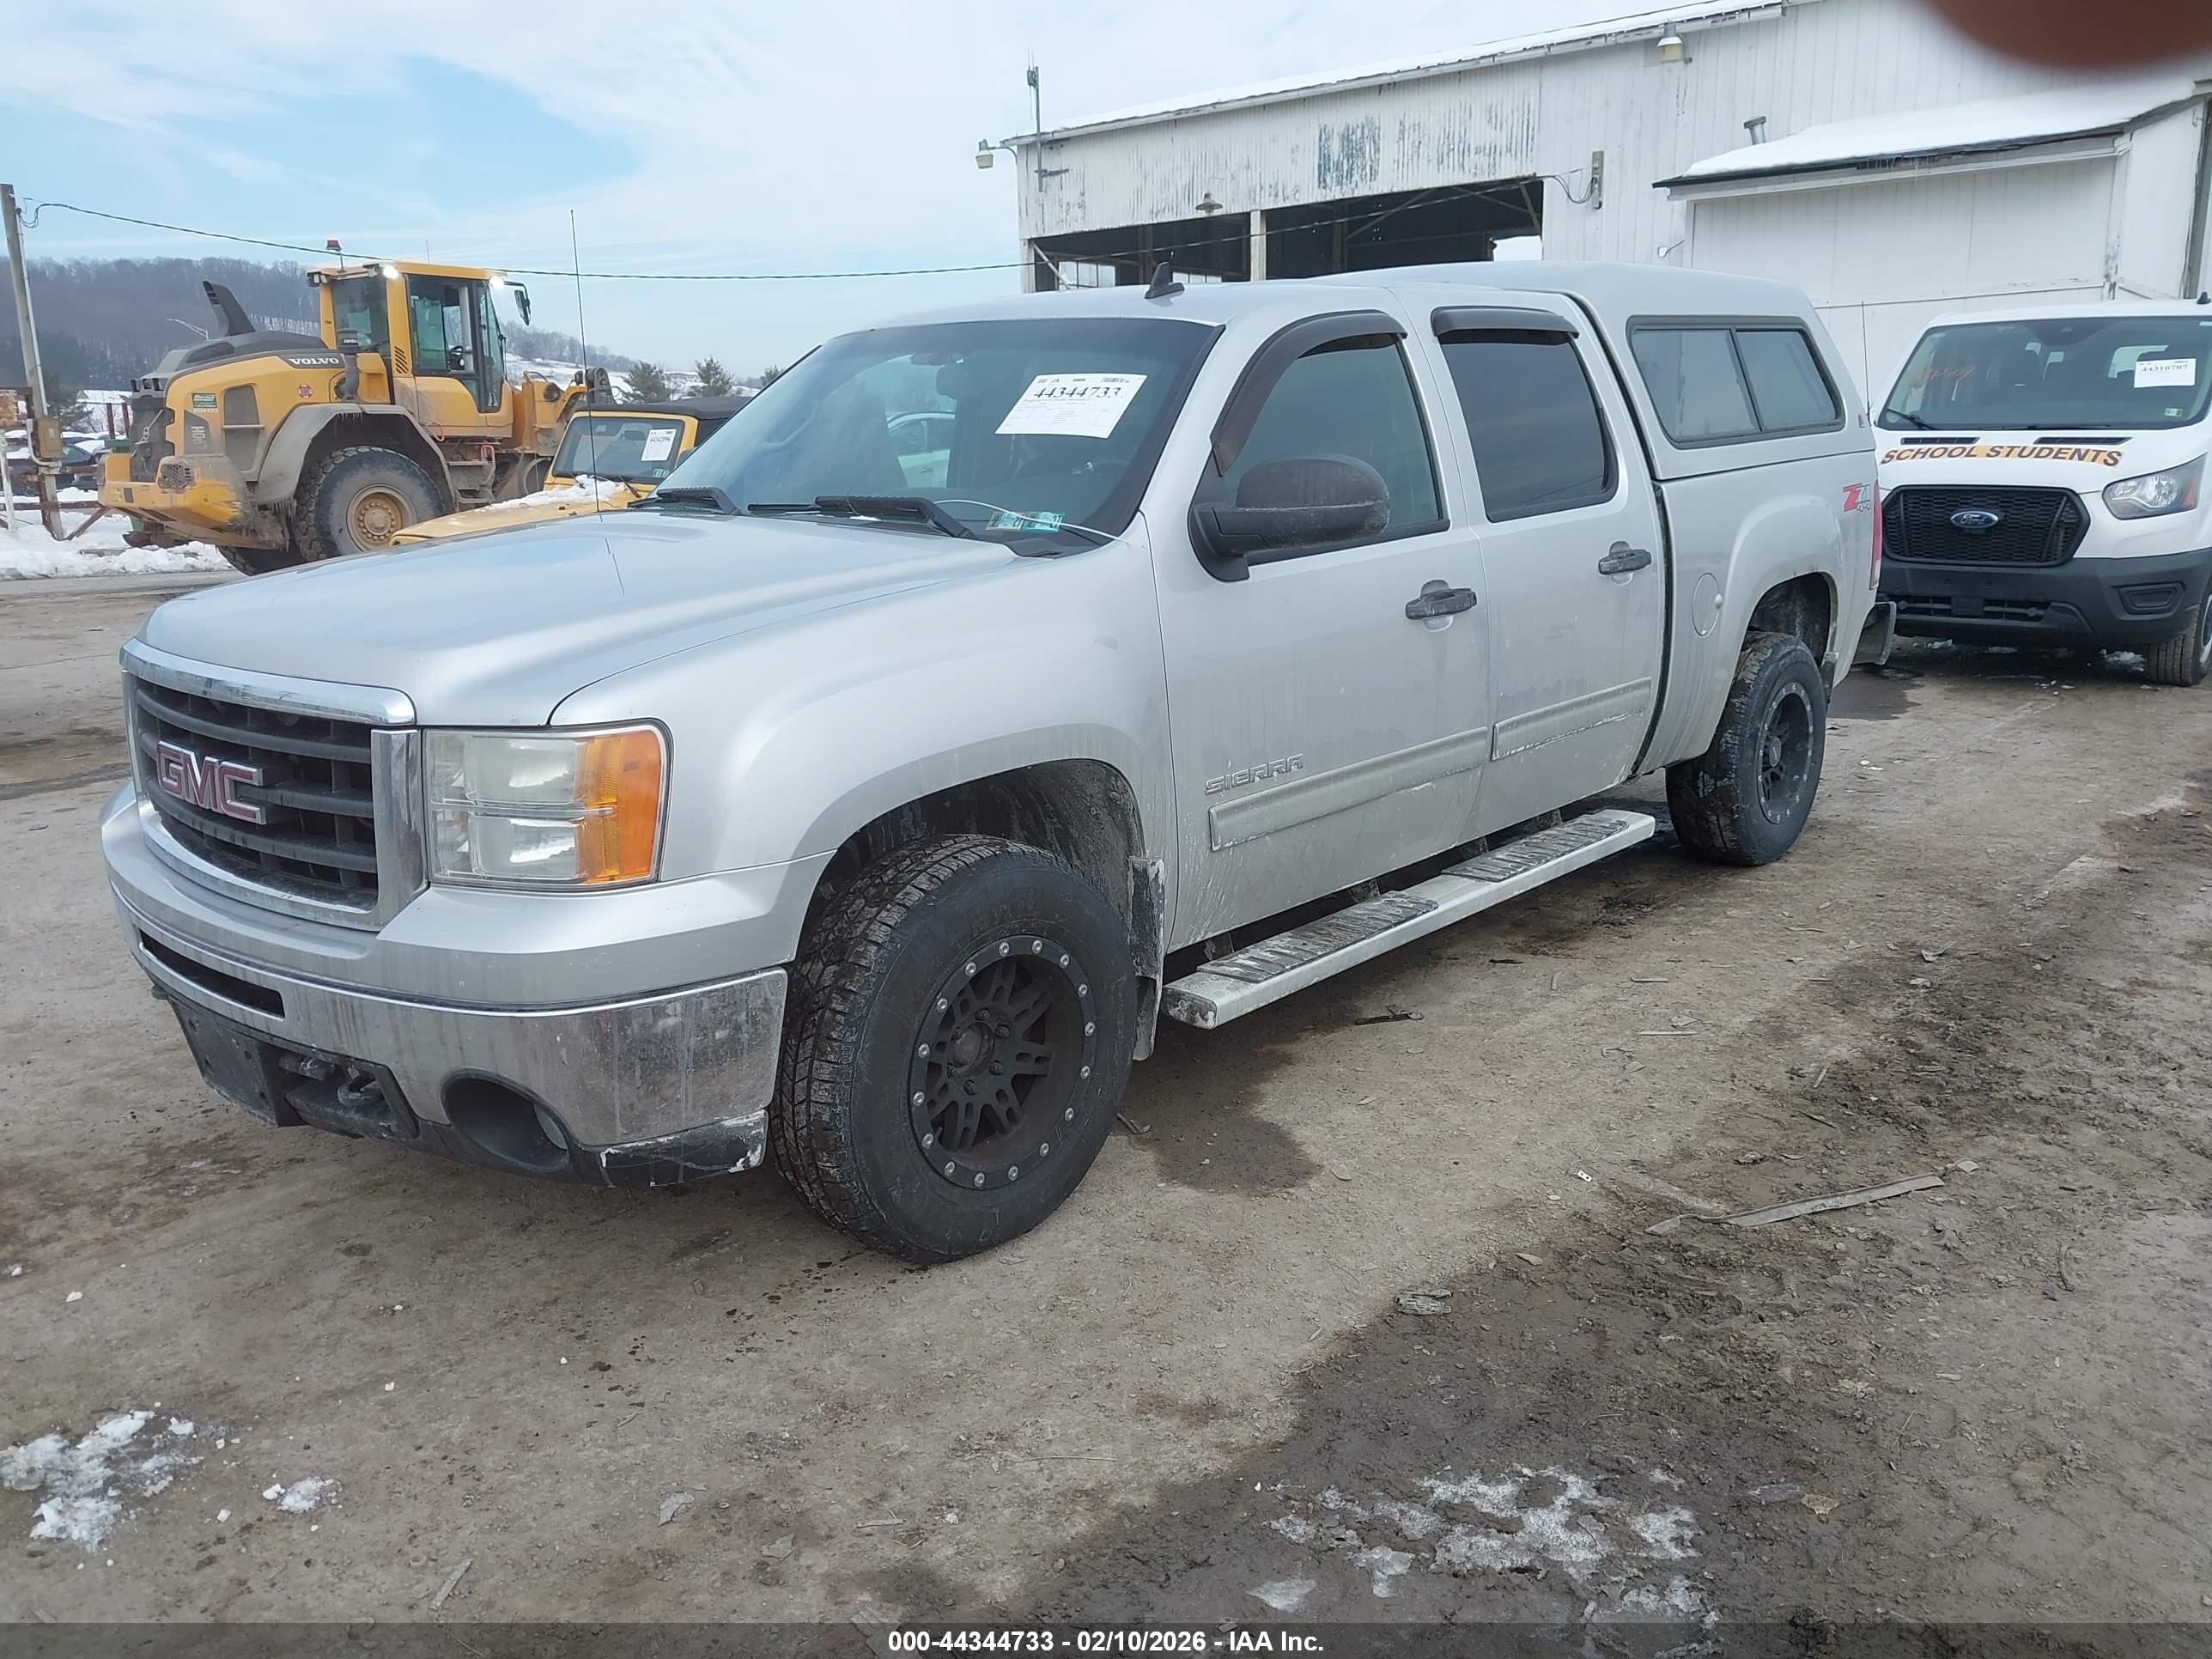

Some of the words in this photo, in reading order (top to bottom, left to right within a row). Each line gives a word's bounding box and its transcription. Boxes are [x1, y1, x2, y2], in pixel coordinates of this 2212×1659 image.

[289, 357, 340, 366] VOLVO
[1033, 386, 1122, 398] 44344733
[1881, 446, 1979, 465] SCHOOL
[1985, 445, 2123, 467] STUDENTS
[1960, 514, 1988, 524] Ford
[157, 740, 267, 825] GMC
[1204, 753, 1304, 796] SIERRA
